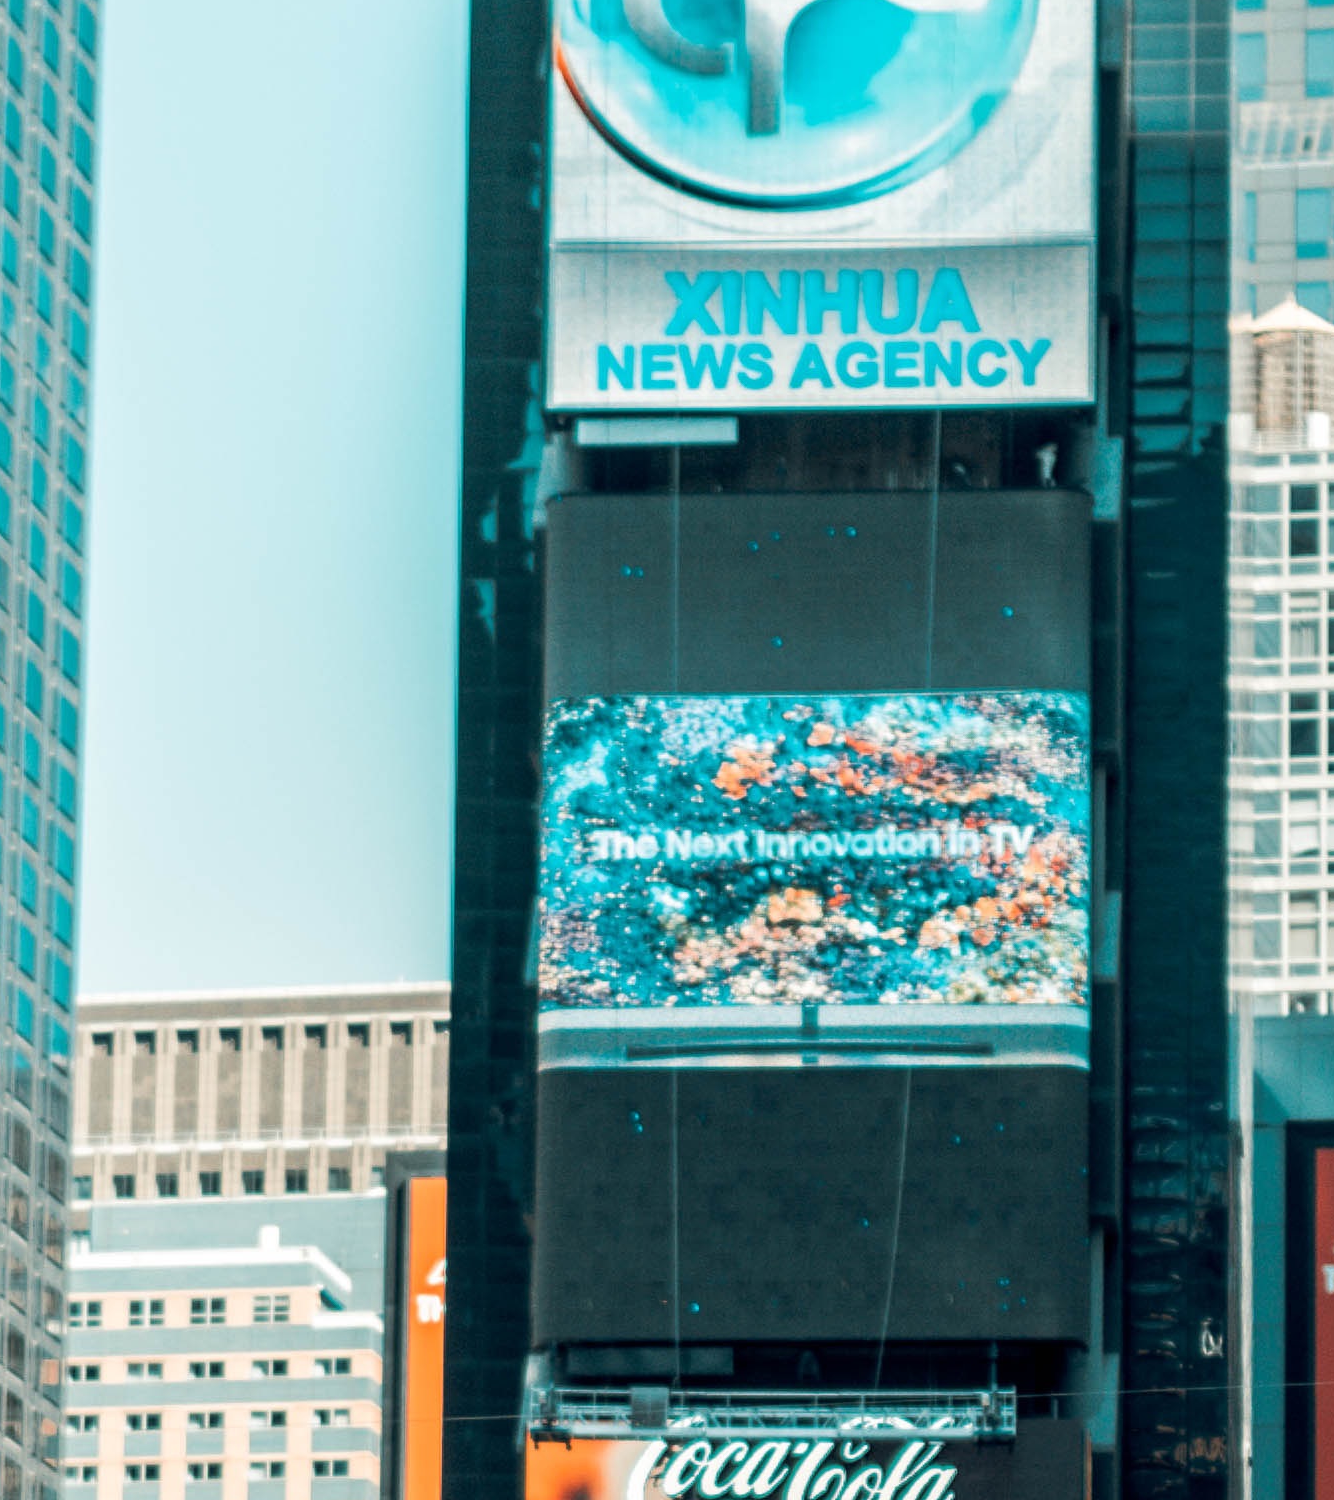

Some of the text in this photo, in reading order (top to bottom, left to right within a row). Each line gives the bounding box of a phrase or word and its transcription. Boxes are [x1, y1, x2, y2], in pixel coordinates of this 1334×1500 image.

[663, 267, 980, 337] XINHUA
[596, 338, 1053, 392] NEWS AGENCY
[593, 829, 655, 860] The
[666, 828, 748, 860] Next
[756, 823, 942, 858] Innovation
[987, 824, 1035, 856] TV
